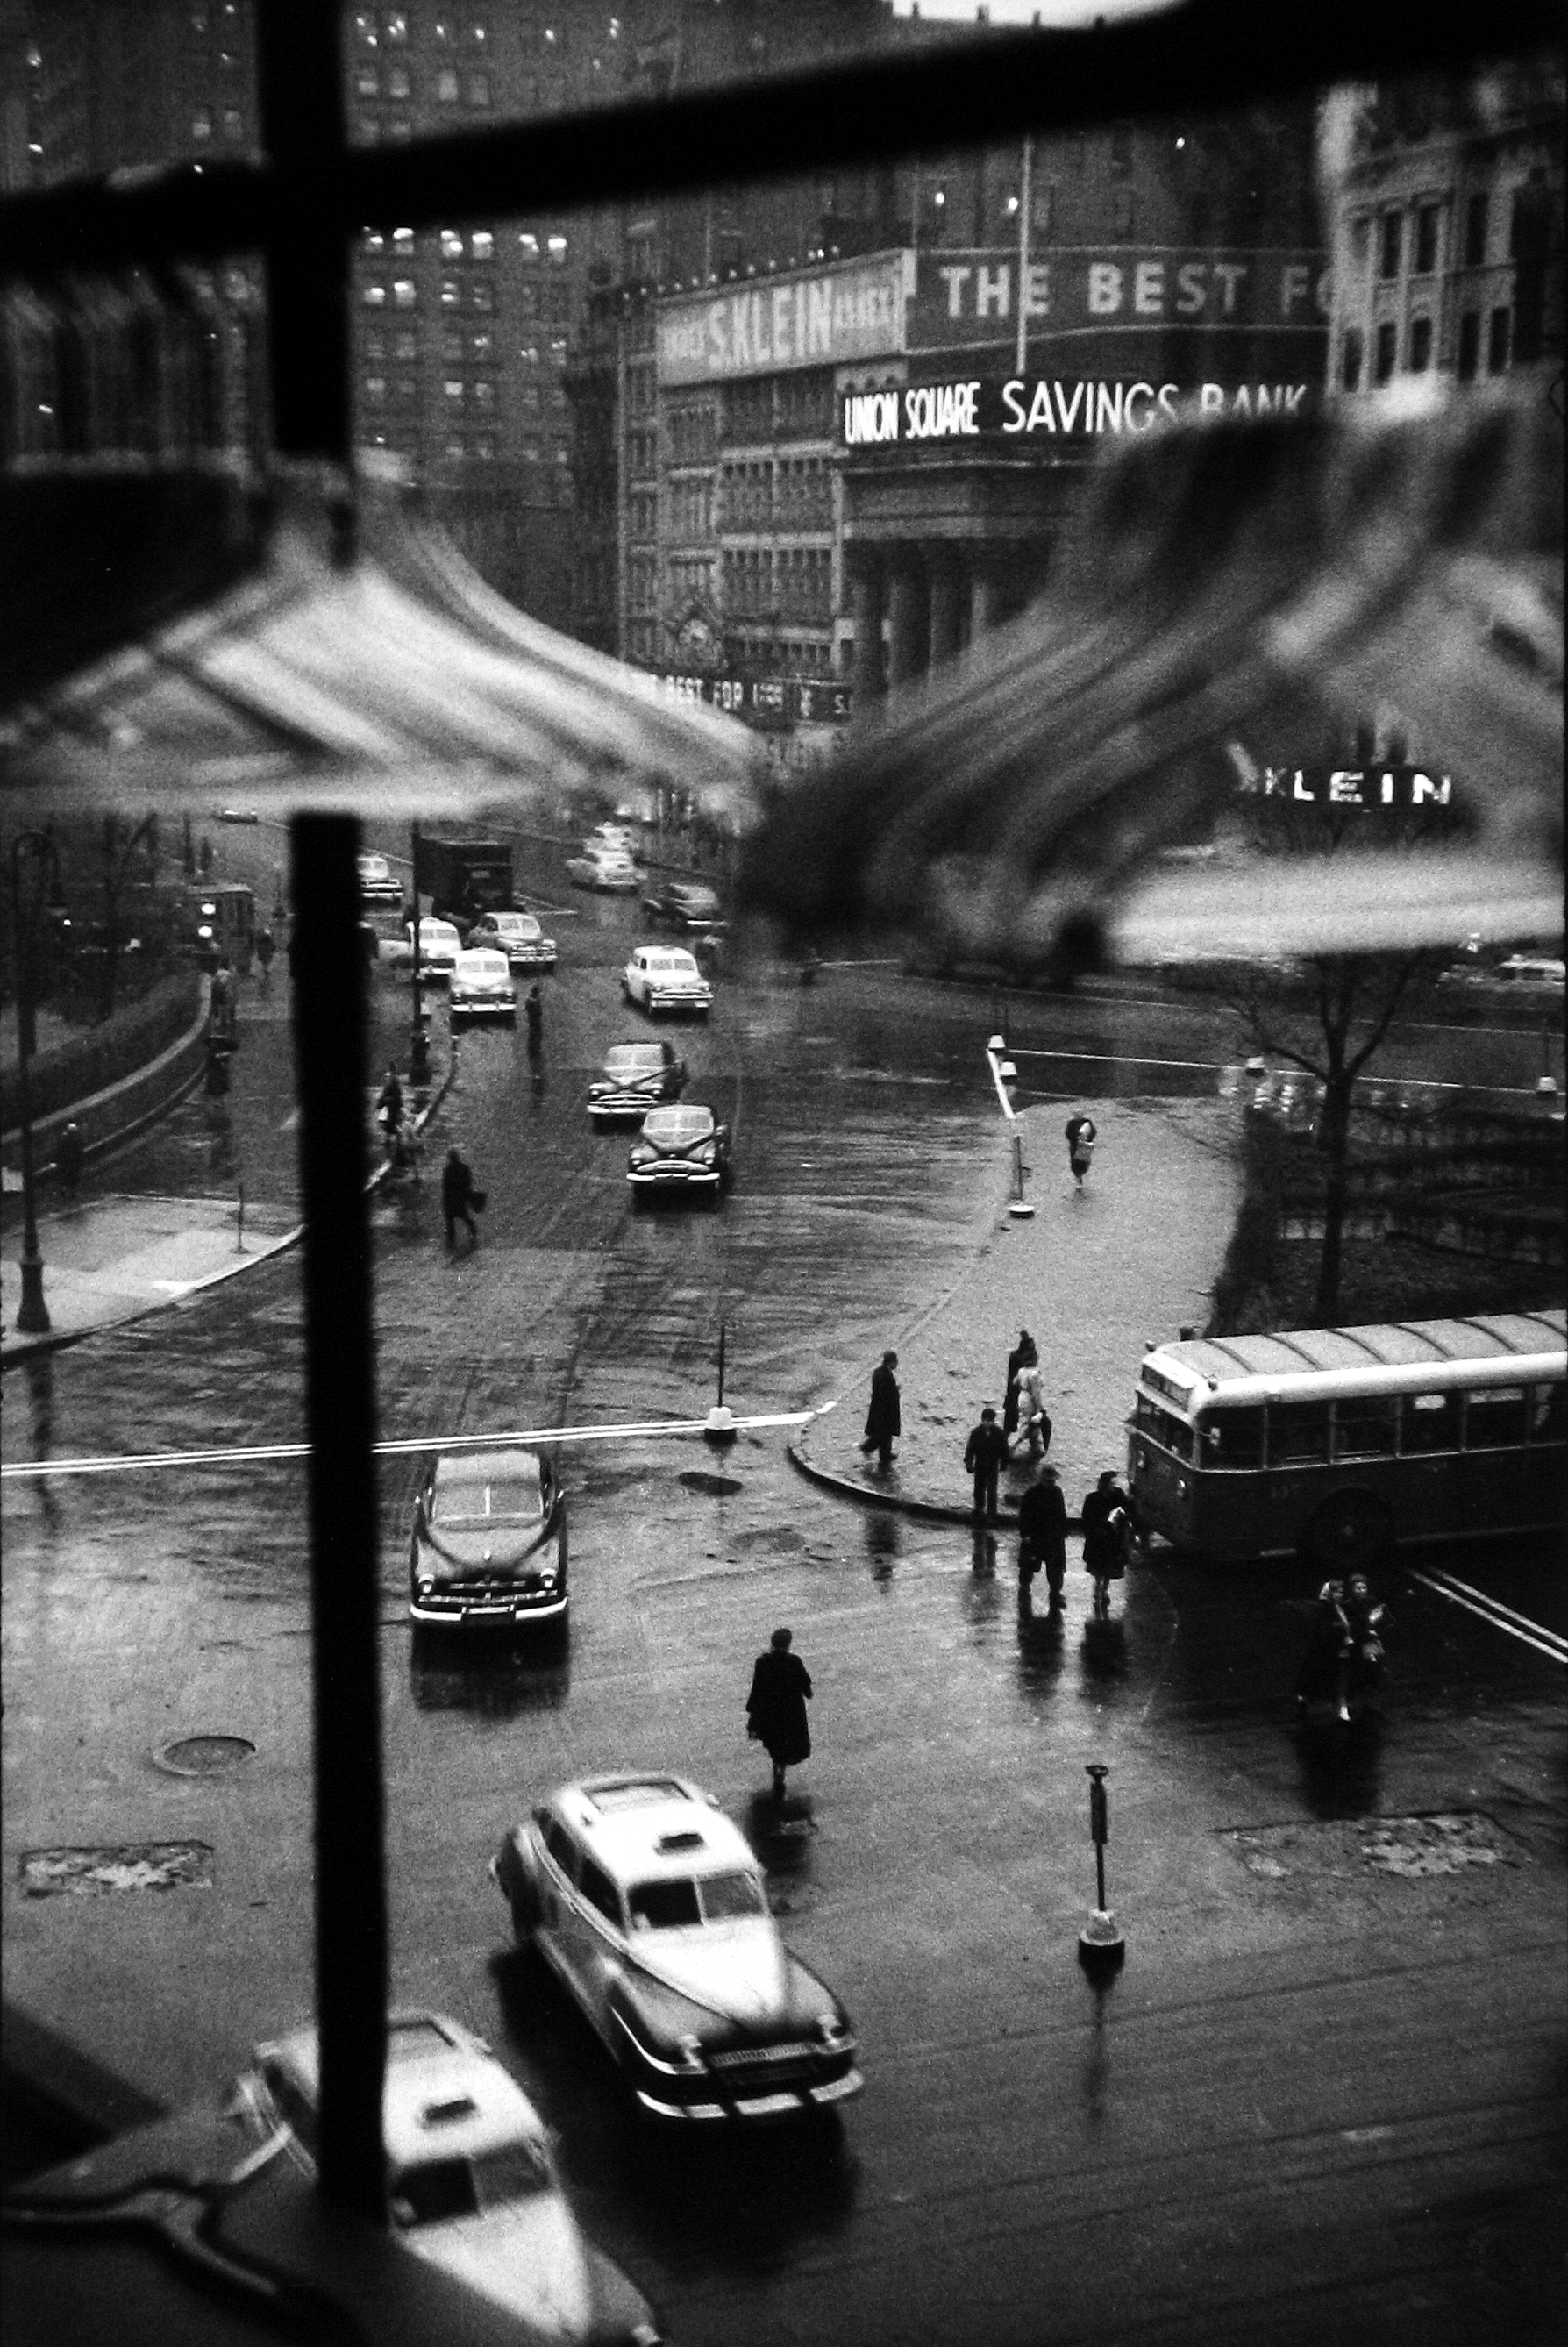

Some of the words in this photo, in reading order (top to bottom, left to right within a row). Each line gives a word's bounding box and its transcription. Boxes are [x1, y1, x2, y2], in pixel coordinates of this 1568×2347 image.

[940, 264, 1050, 317] THE
[1088, 262, 1247, 314] BEST
[845, 391, 899, 444] UNION
[905, 381, 981, 439] SQUARE
[1002, 380, 1180, 433] SAVINGS
